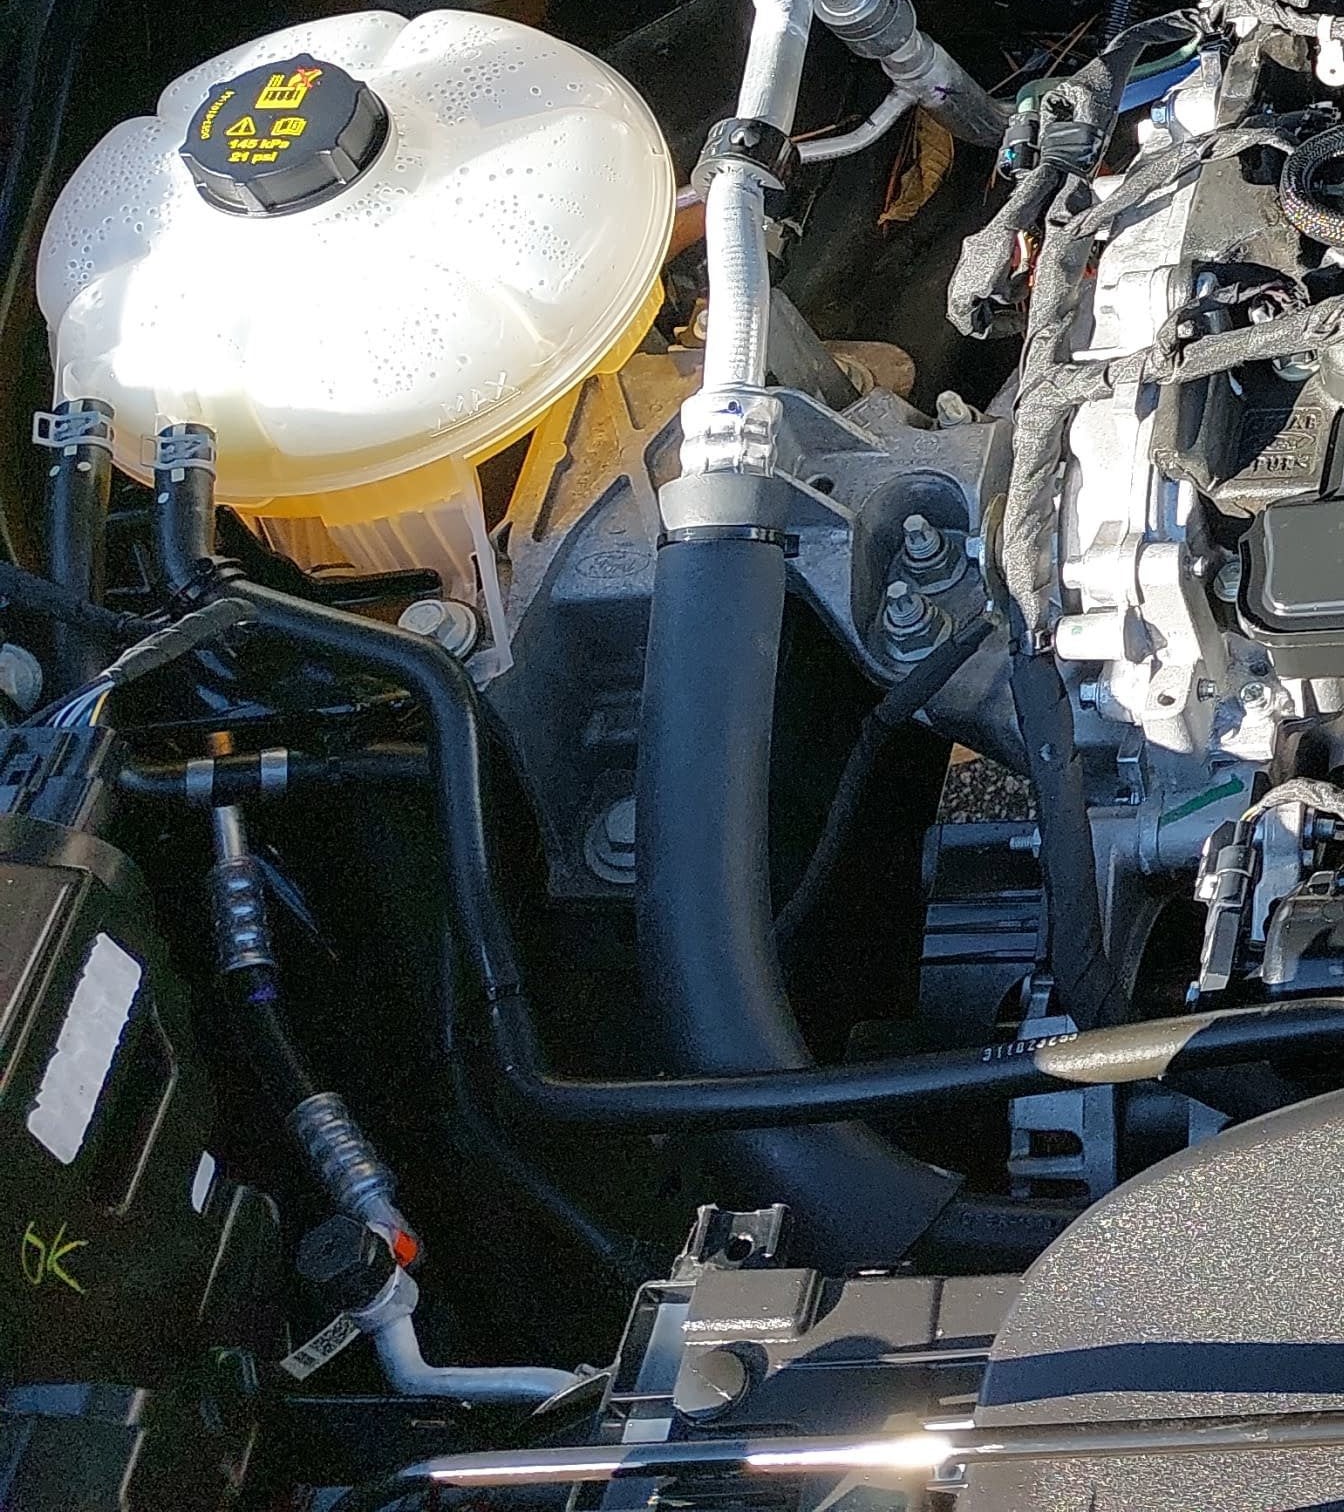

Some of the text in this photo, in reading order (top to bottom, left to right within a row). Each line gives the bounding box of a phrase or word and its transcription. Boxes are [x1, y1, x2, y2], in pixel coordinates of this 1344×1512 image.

[228, 139, 291, 149] 145 kPa
[228, 151, 279, 165] 21 psi
[21, 1221, 90, 1296] OK
